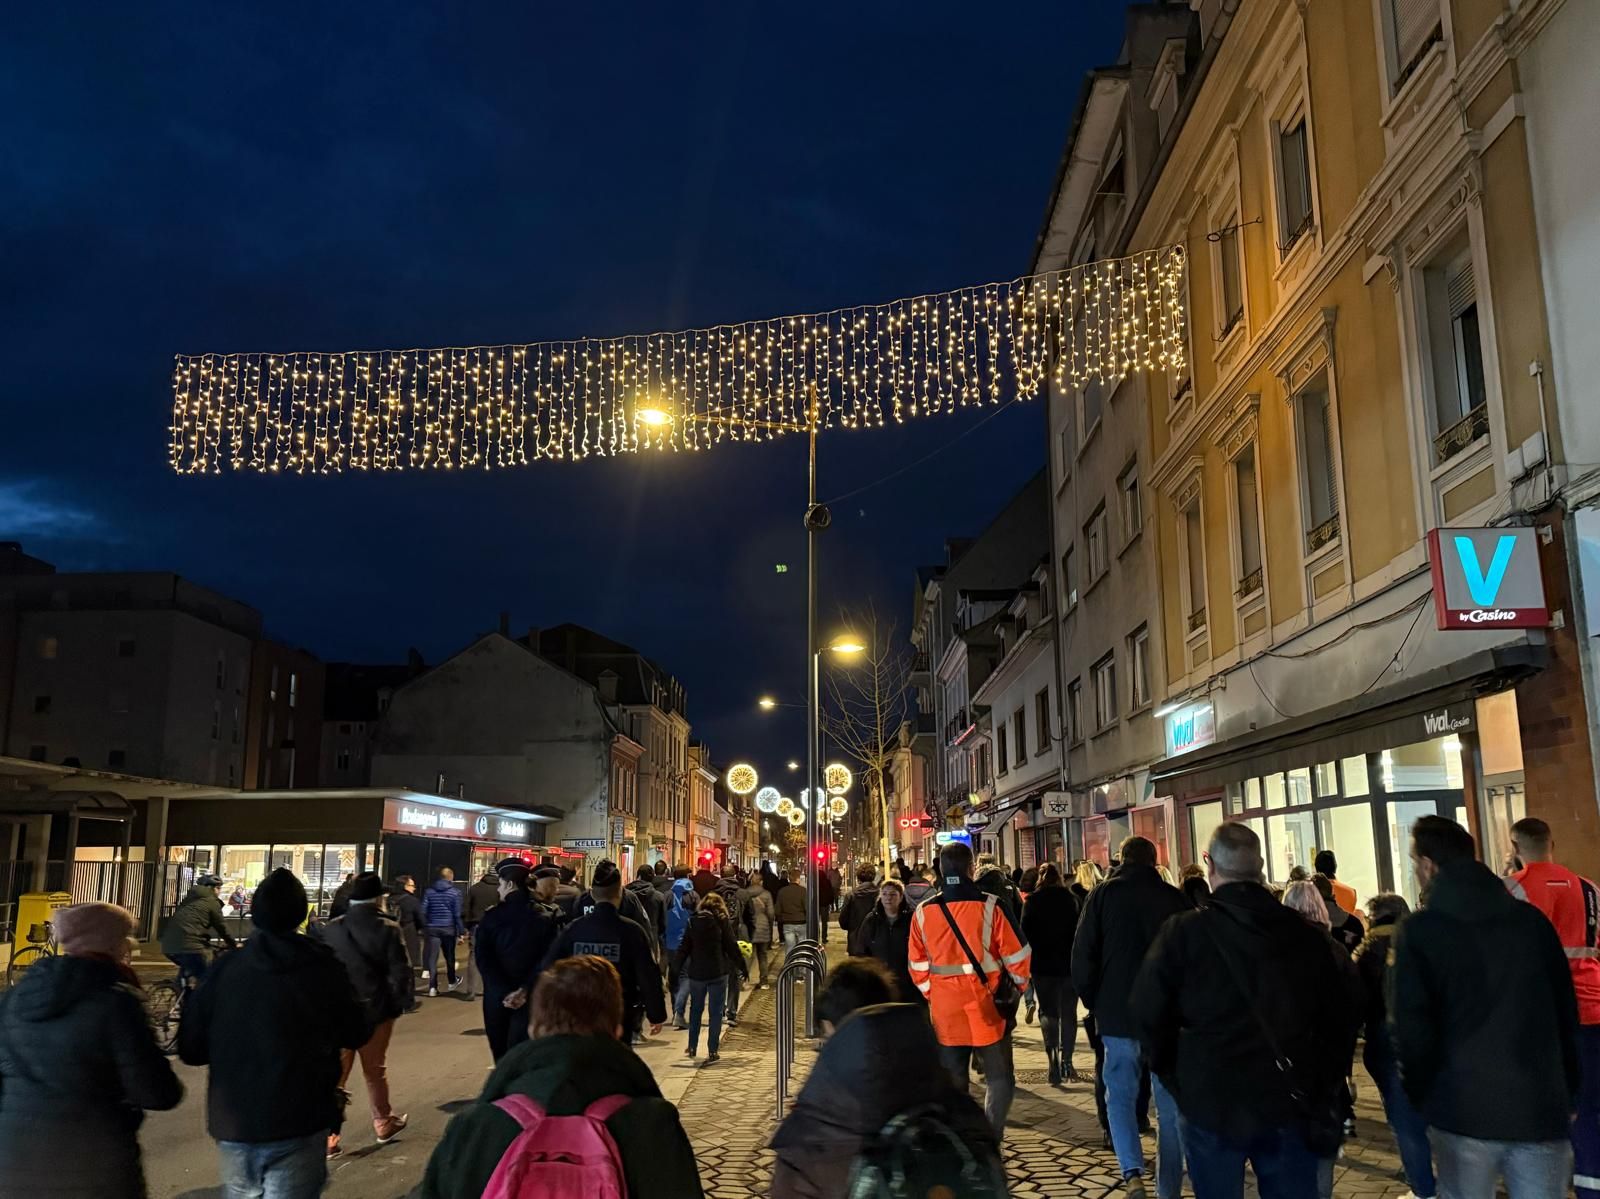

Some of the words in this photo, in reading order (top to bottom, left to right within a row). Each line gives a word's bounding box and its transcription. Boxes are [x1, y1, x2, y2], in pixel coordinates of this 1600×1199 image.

[1454, 535, 1517, 607] V
[1469, 609, 1517, 622] Casino
[575, 943, 619, 957] POLICE
